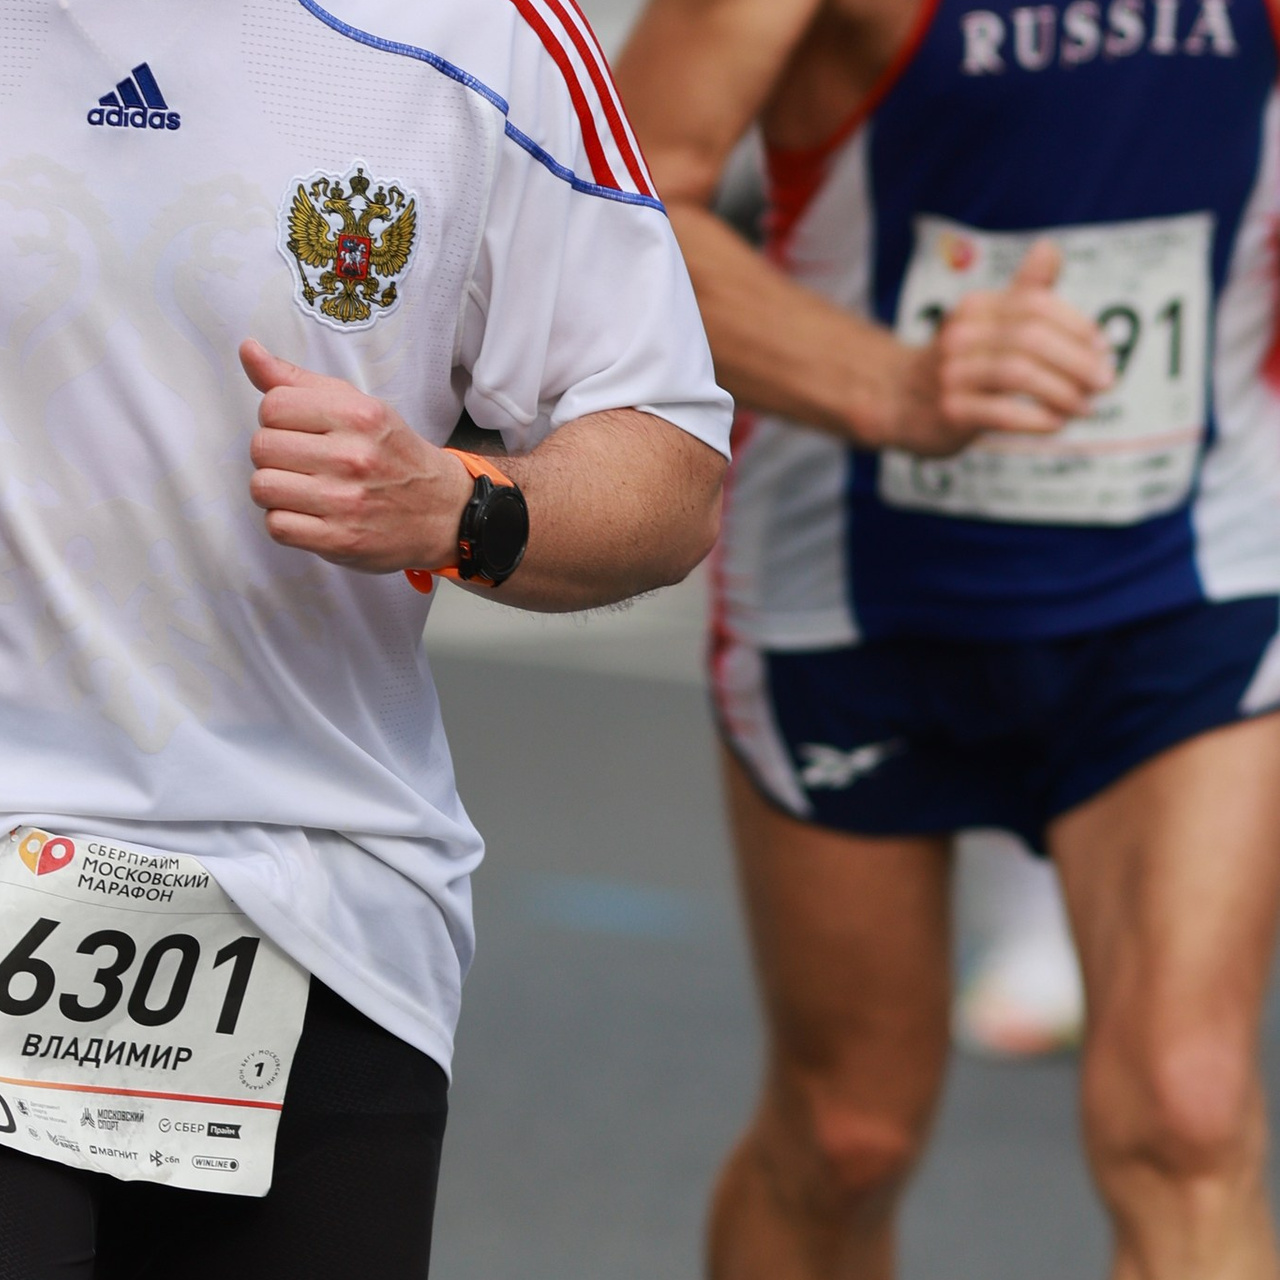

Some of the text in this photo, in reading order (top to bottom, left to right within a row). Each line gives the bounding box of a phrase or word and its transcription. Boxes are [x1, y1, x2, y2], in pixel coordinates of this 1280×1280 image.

[87, 105, 181, 130] adidas
[87, 842, 180, 870] СБЕРПРАЙМ
[82, 857, 210, 888] МОСКОВСКИЙ
[77, 874, 174, 903] МАРАФОН
[21, 1034, 193, 1070] ВЛАДИМИР
[254, 1062, 265, 1077] 1
[97, 1108, 145, 1123] МОСКОВСКИЙ
[97, 1120, 119, 1132] СПОРТ
[174, 1121, 205, 1133] СБЕР
[195, 1159, 228, 1169] WINLINE
